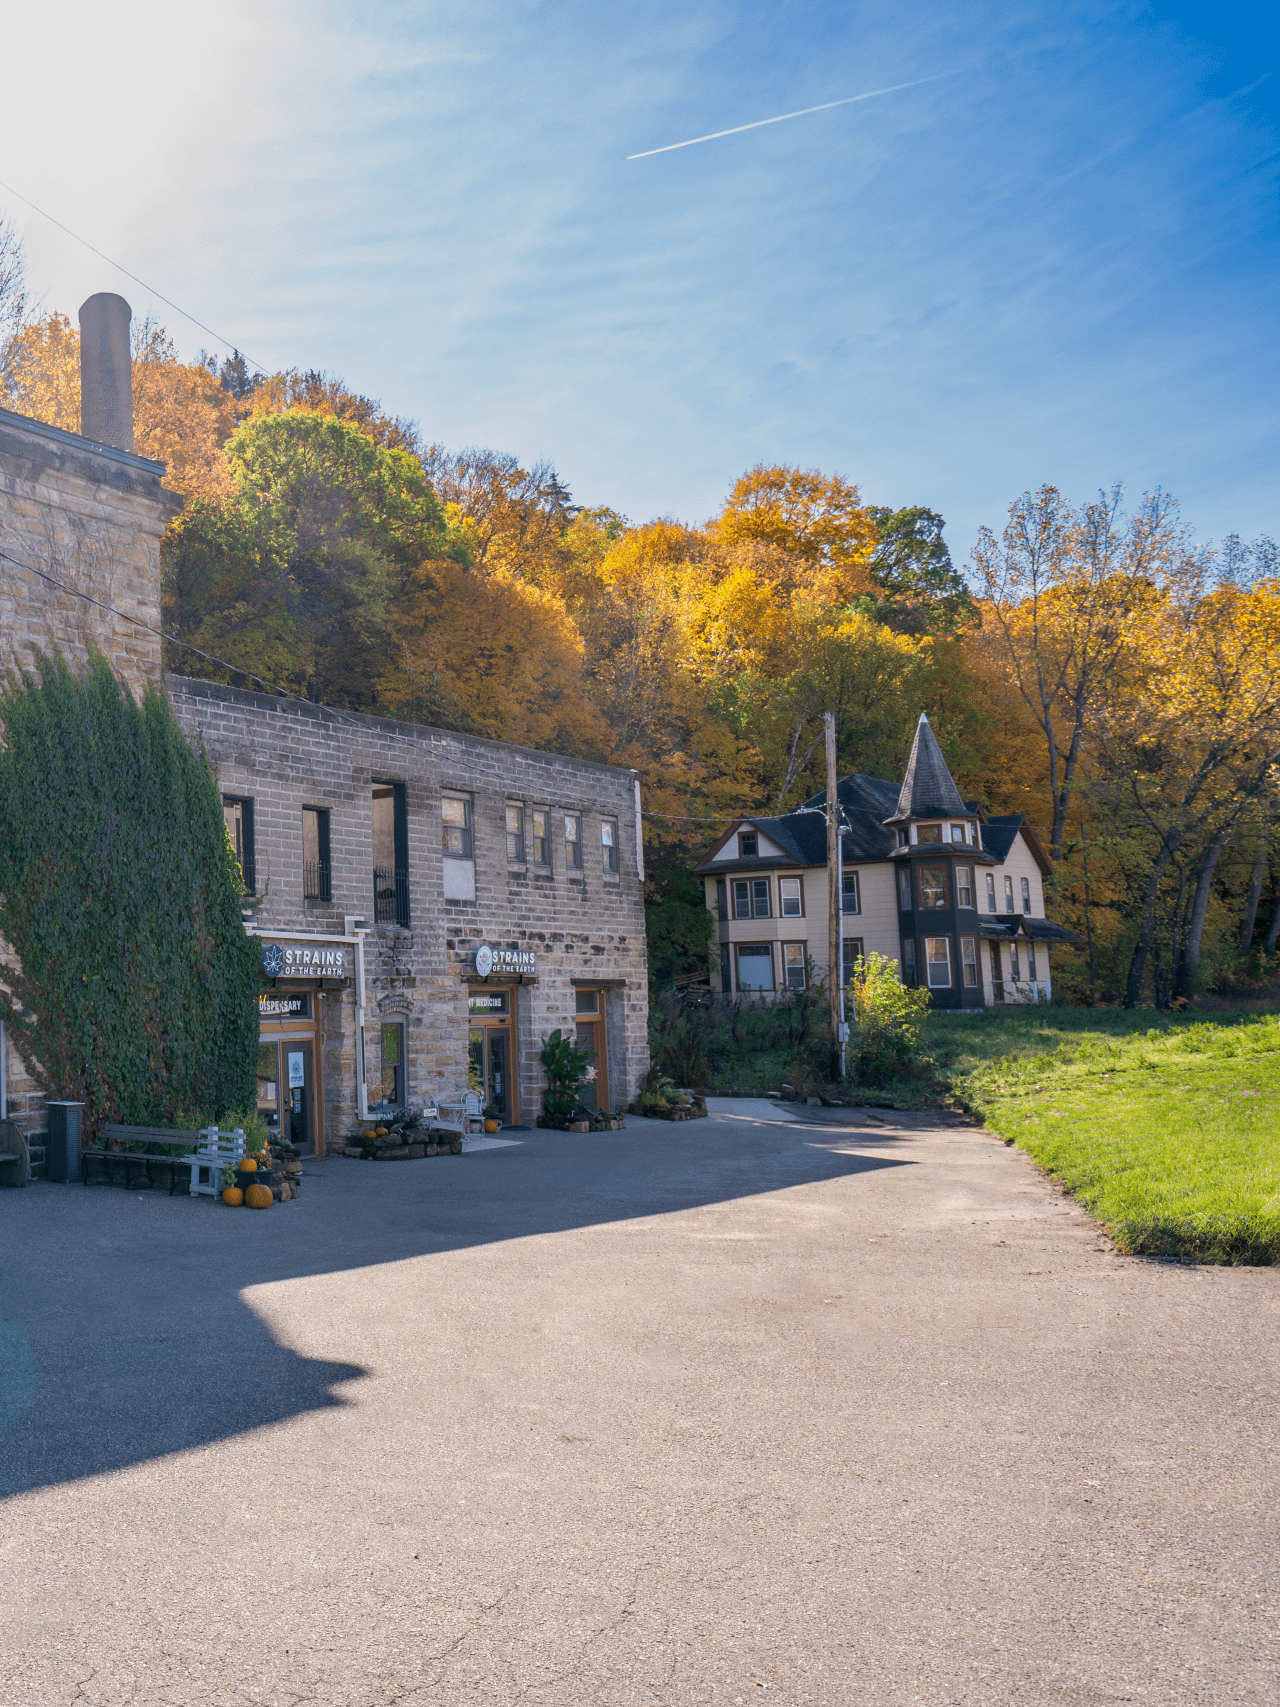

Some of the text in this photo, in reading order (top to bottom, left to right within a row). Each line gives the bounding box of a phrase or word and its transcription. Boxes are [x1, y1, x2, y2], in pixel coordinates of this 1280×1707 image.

[285, 949, 343, 966] STRAINS
[492, 950, 535, 964] STRAINS
[284, 966, 342, 976] OF THE EARTH
[492, 964, 535, 973] OF THE EARTH
